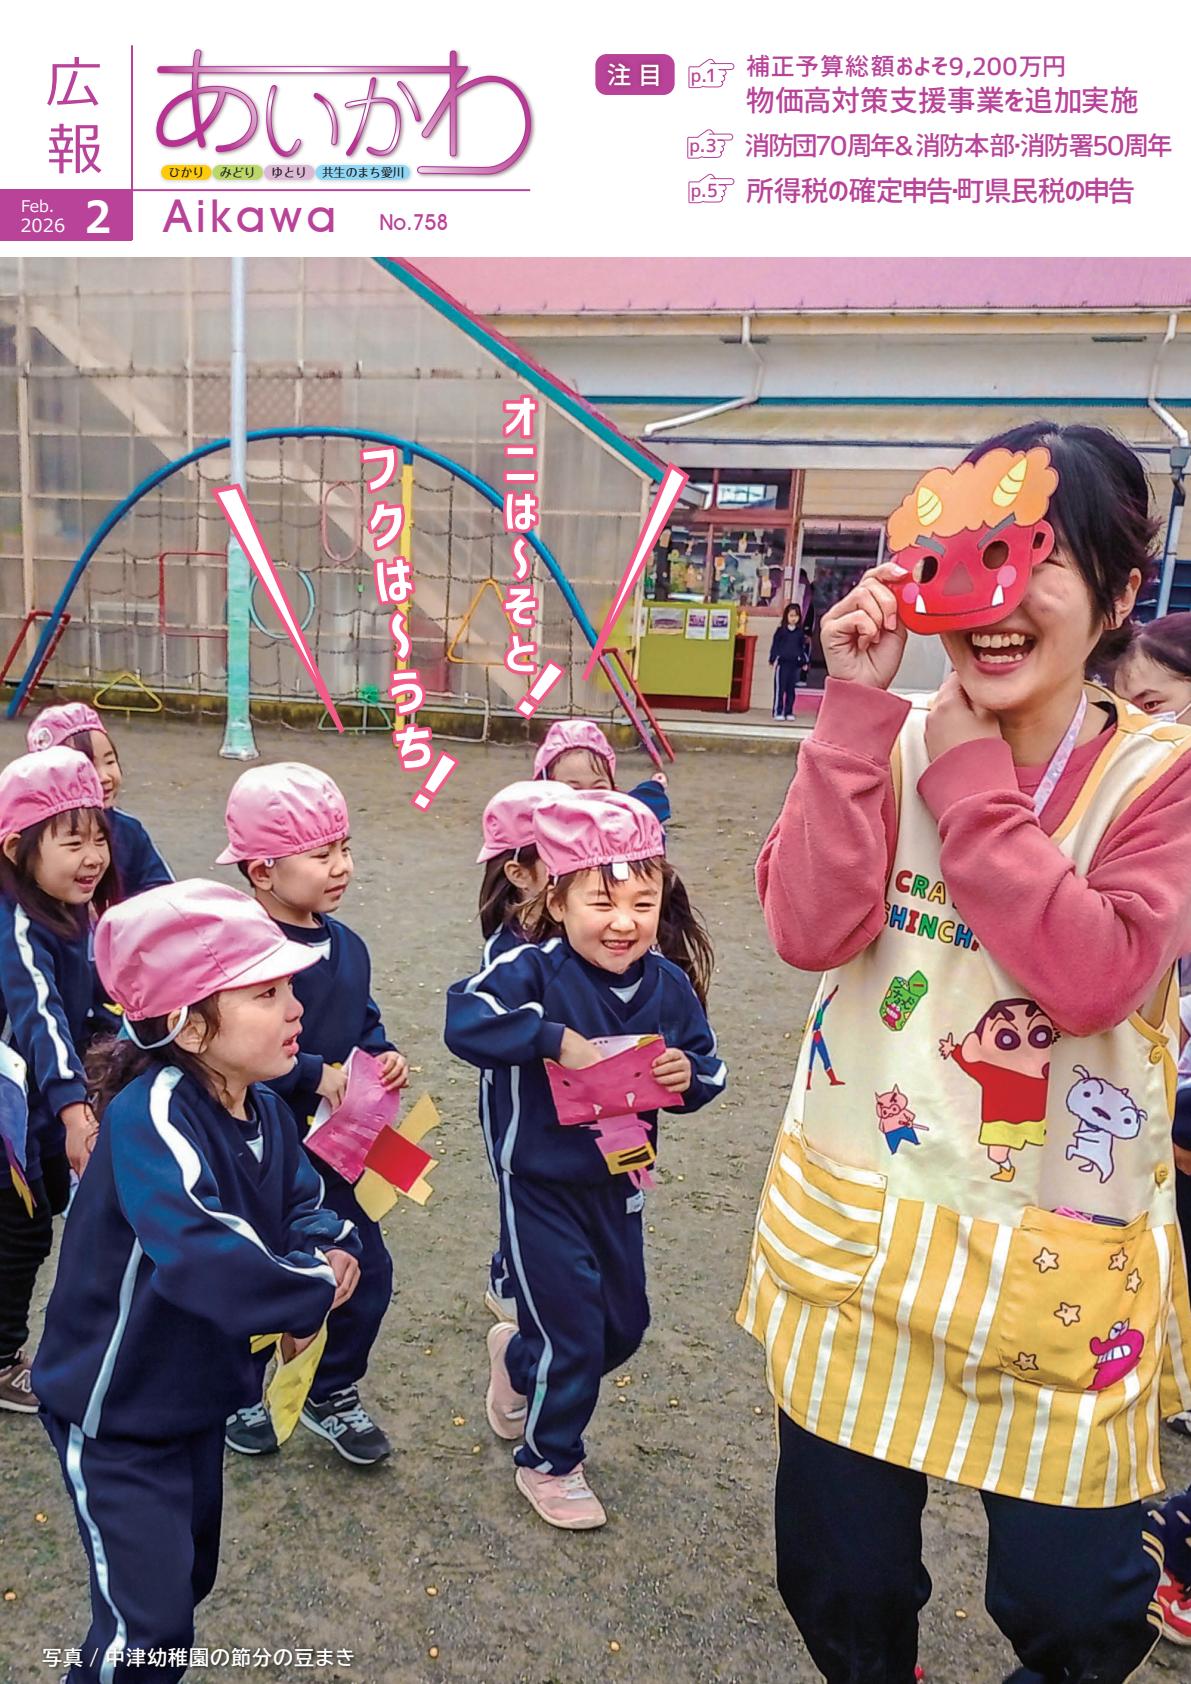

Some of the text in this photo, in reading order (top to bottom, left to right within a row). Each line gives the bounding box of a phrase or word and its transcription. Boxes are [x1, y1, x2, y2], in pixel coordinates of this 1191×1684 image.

[607, 63, 659, 87] 注目
[746, 54, 1065, 79] 補正予算総額およそ9,200万円
[691, 68, 714, 86] p.1
[746, 86, 1138, 114] 物価高対策支援事業を追加実施
[47, 57, 101, 173] 広報
[156, 49, 533, 176] あいかわ
[690, 138, 716, 156] p.3
[169, 167, 203, 178] ひかり
[220, 167, 254, 178] みどり
[272, 167, 306, 178] ゆとり
[322, 166, 404, 178] 共生のまち愛川
[691, 183, 717, 201] p.5
[21, 199, 53, 213] Feb.
[86, 200, 110, 234] 2
[162, 199, 334, 233] Aikawa
[379, 213, 448, 231] No.758
[21, 218, 65, 233] 2026
[895, 870, 958, 910] CRA
[884, 901, 979, 951] HINCH
